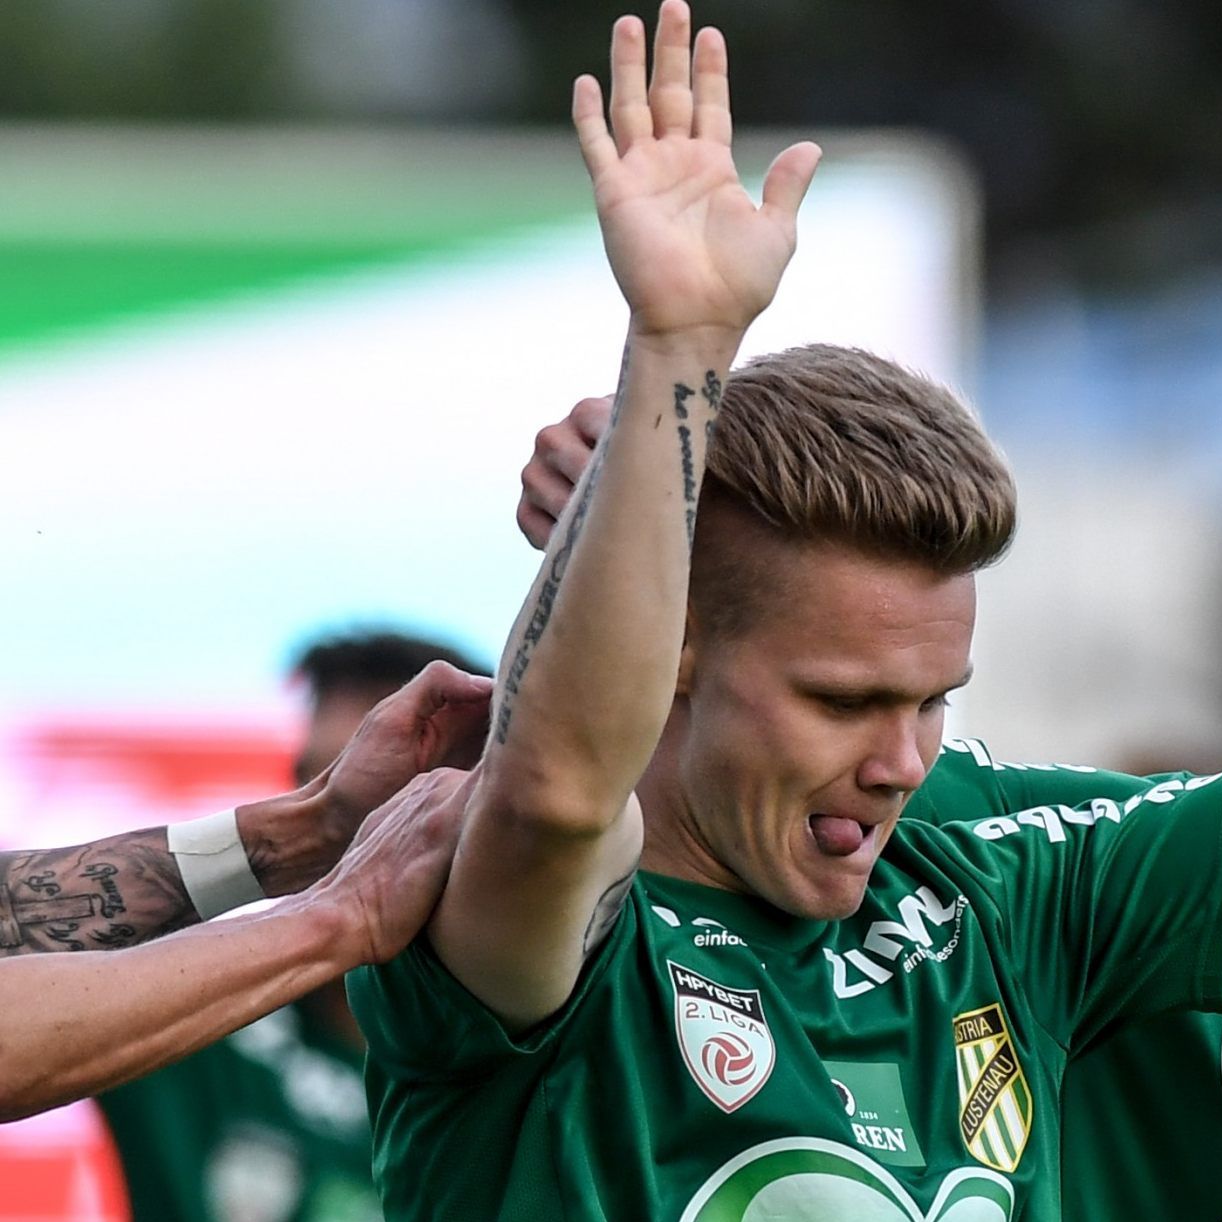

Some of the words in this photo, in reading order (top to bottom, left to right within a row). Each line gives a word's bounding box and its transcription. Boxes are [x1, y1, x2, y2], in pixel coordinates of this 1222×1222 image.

[675, 970, 753, 1012] HPYBET
[685, 1002, 705, 1019] 2.
[709, 1005, 764, 1037] LIGA
[955, 1016, 993, 1042] STRIA
[962, 1054, 1014, 1137] LUSTENAU
[851, 1122, 907, 1152] REN
